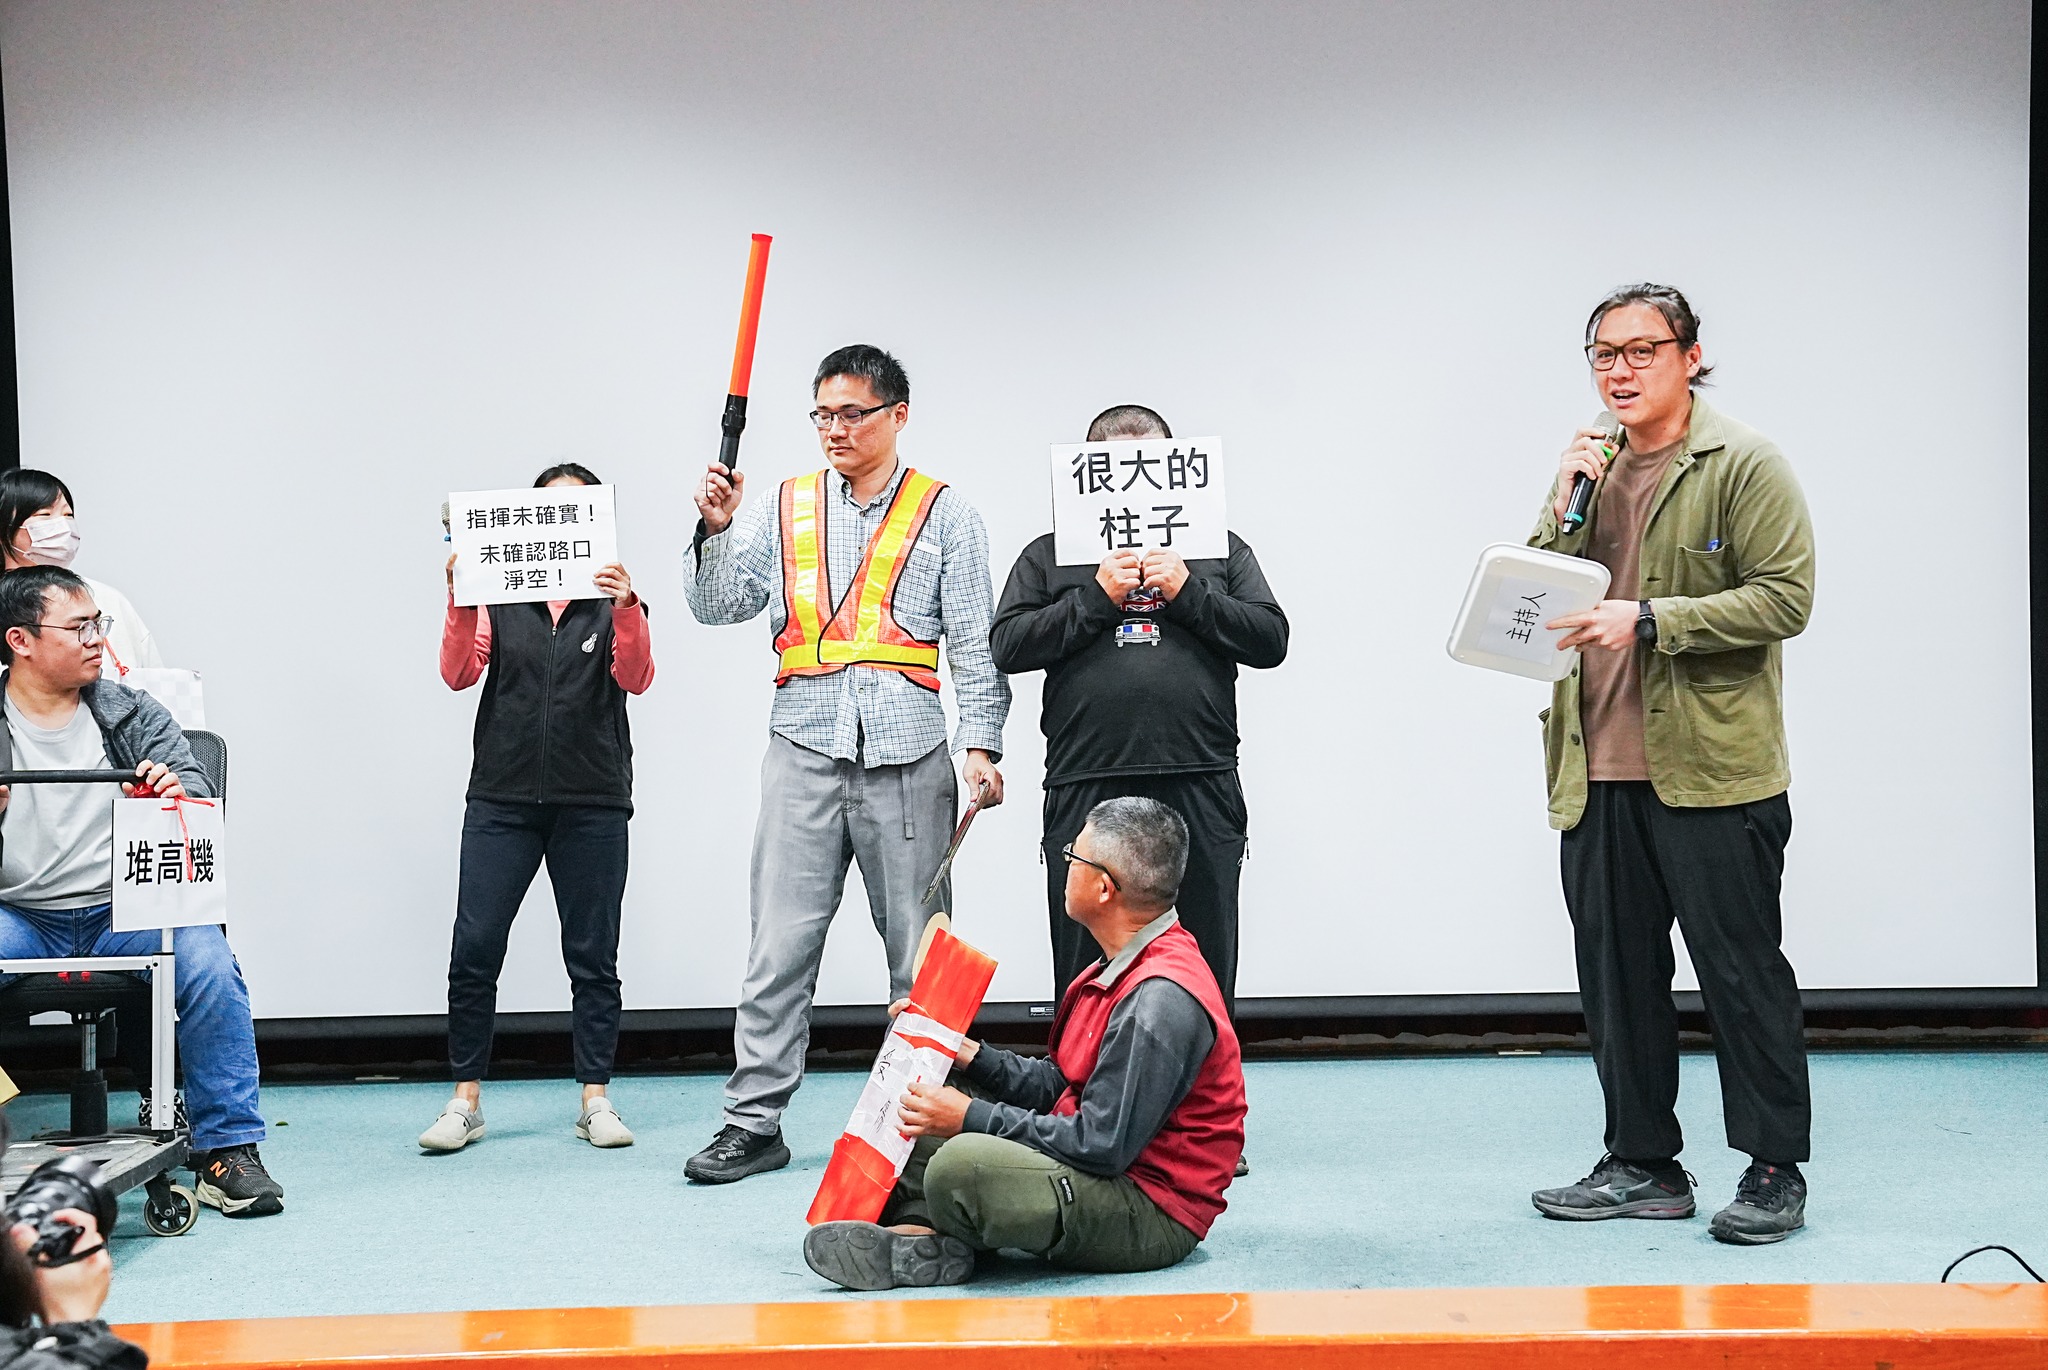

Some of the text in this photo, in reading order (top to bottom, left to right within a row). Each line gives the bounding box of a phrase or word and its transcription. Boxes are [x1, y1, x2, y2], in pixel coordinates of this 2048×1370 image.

[1071, 447, 1208, 495] 很大的
[466, 503, 594, 530] 指揮未確實！
[1099, 505, 1190, 551] 柱子
[480, 540, 591, 565] 未確認路口
[504, 568, 563, 591] 淨空！
[1505, 592, 1547, 644] 主持人
[124, 838, 214, 886] 堆高機
